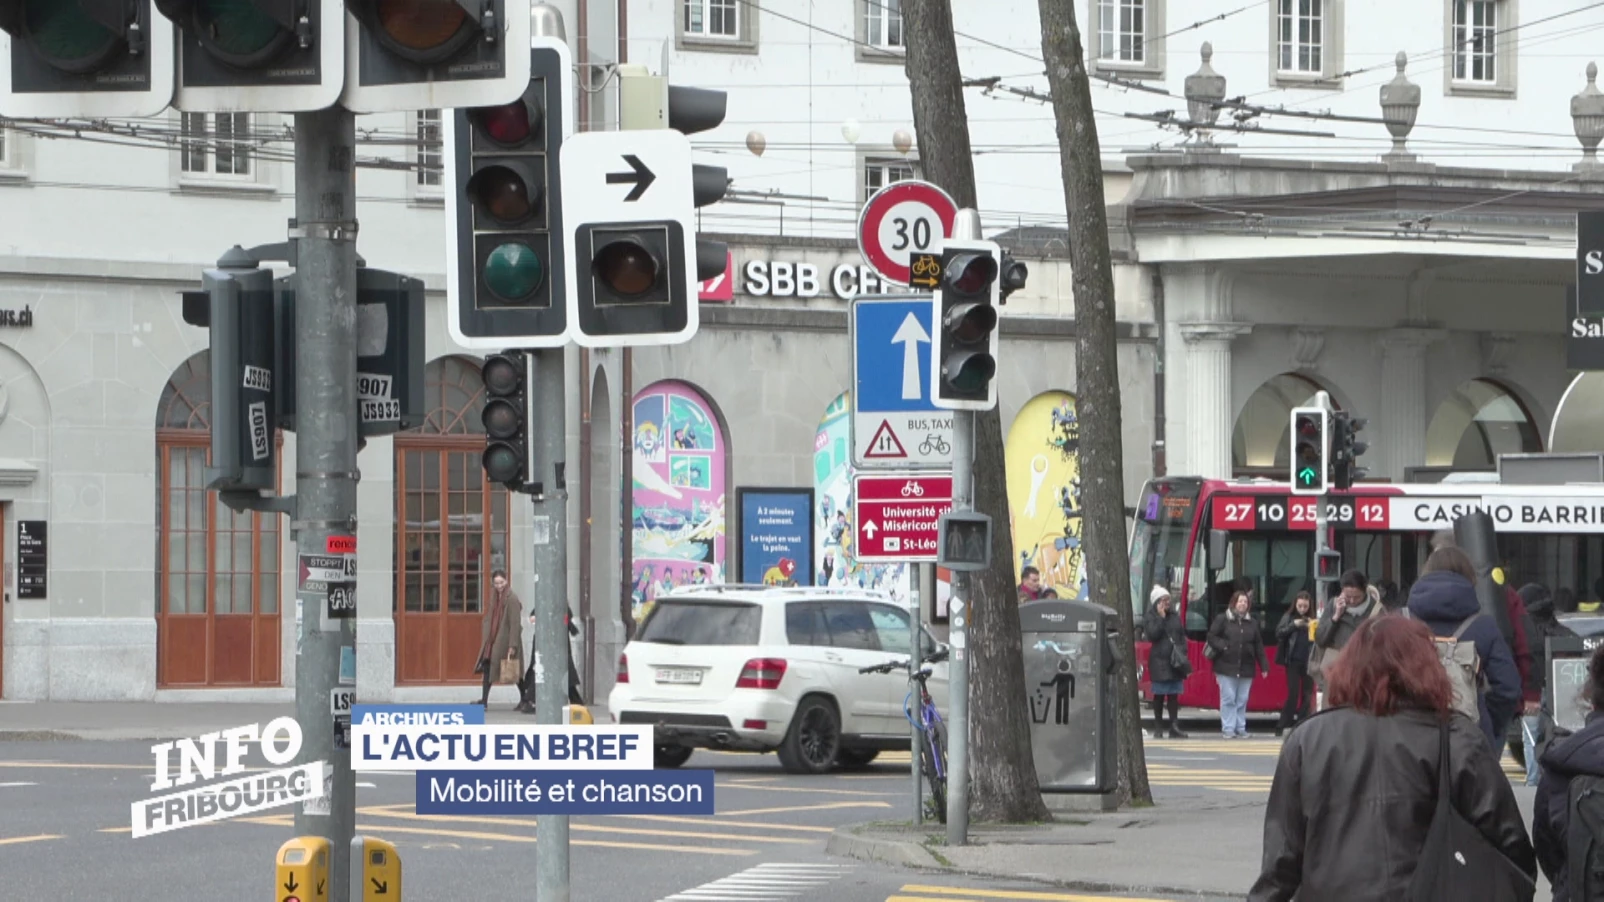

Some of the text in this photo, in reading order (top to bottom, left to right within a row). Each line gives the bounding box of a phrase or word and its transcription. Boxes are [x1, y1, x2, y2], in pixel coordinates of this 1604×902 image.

[891, 216, 931, 250] 30
[745, 260, 820, 298] SBB
[0, 304, 33, 327] rs.ch
[1572, 318, 1604, 338] Sa
[357, 377, 389, 396] 907
[363, 401, 400, 420] JS932
[252, 407, 267, 456] LS907
[908, 418, 953, 431] BUS, TAXI
[883, 505, 936, 518] Université
[1224, 504, 1384, 522] 27 10 25 29 12
[1521, 505, 1604, 524] BARRI
[883, 519, 938, 531] Miséricord
